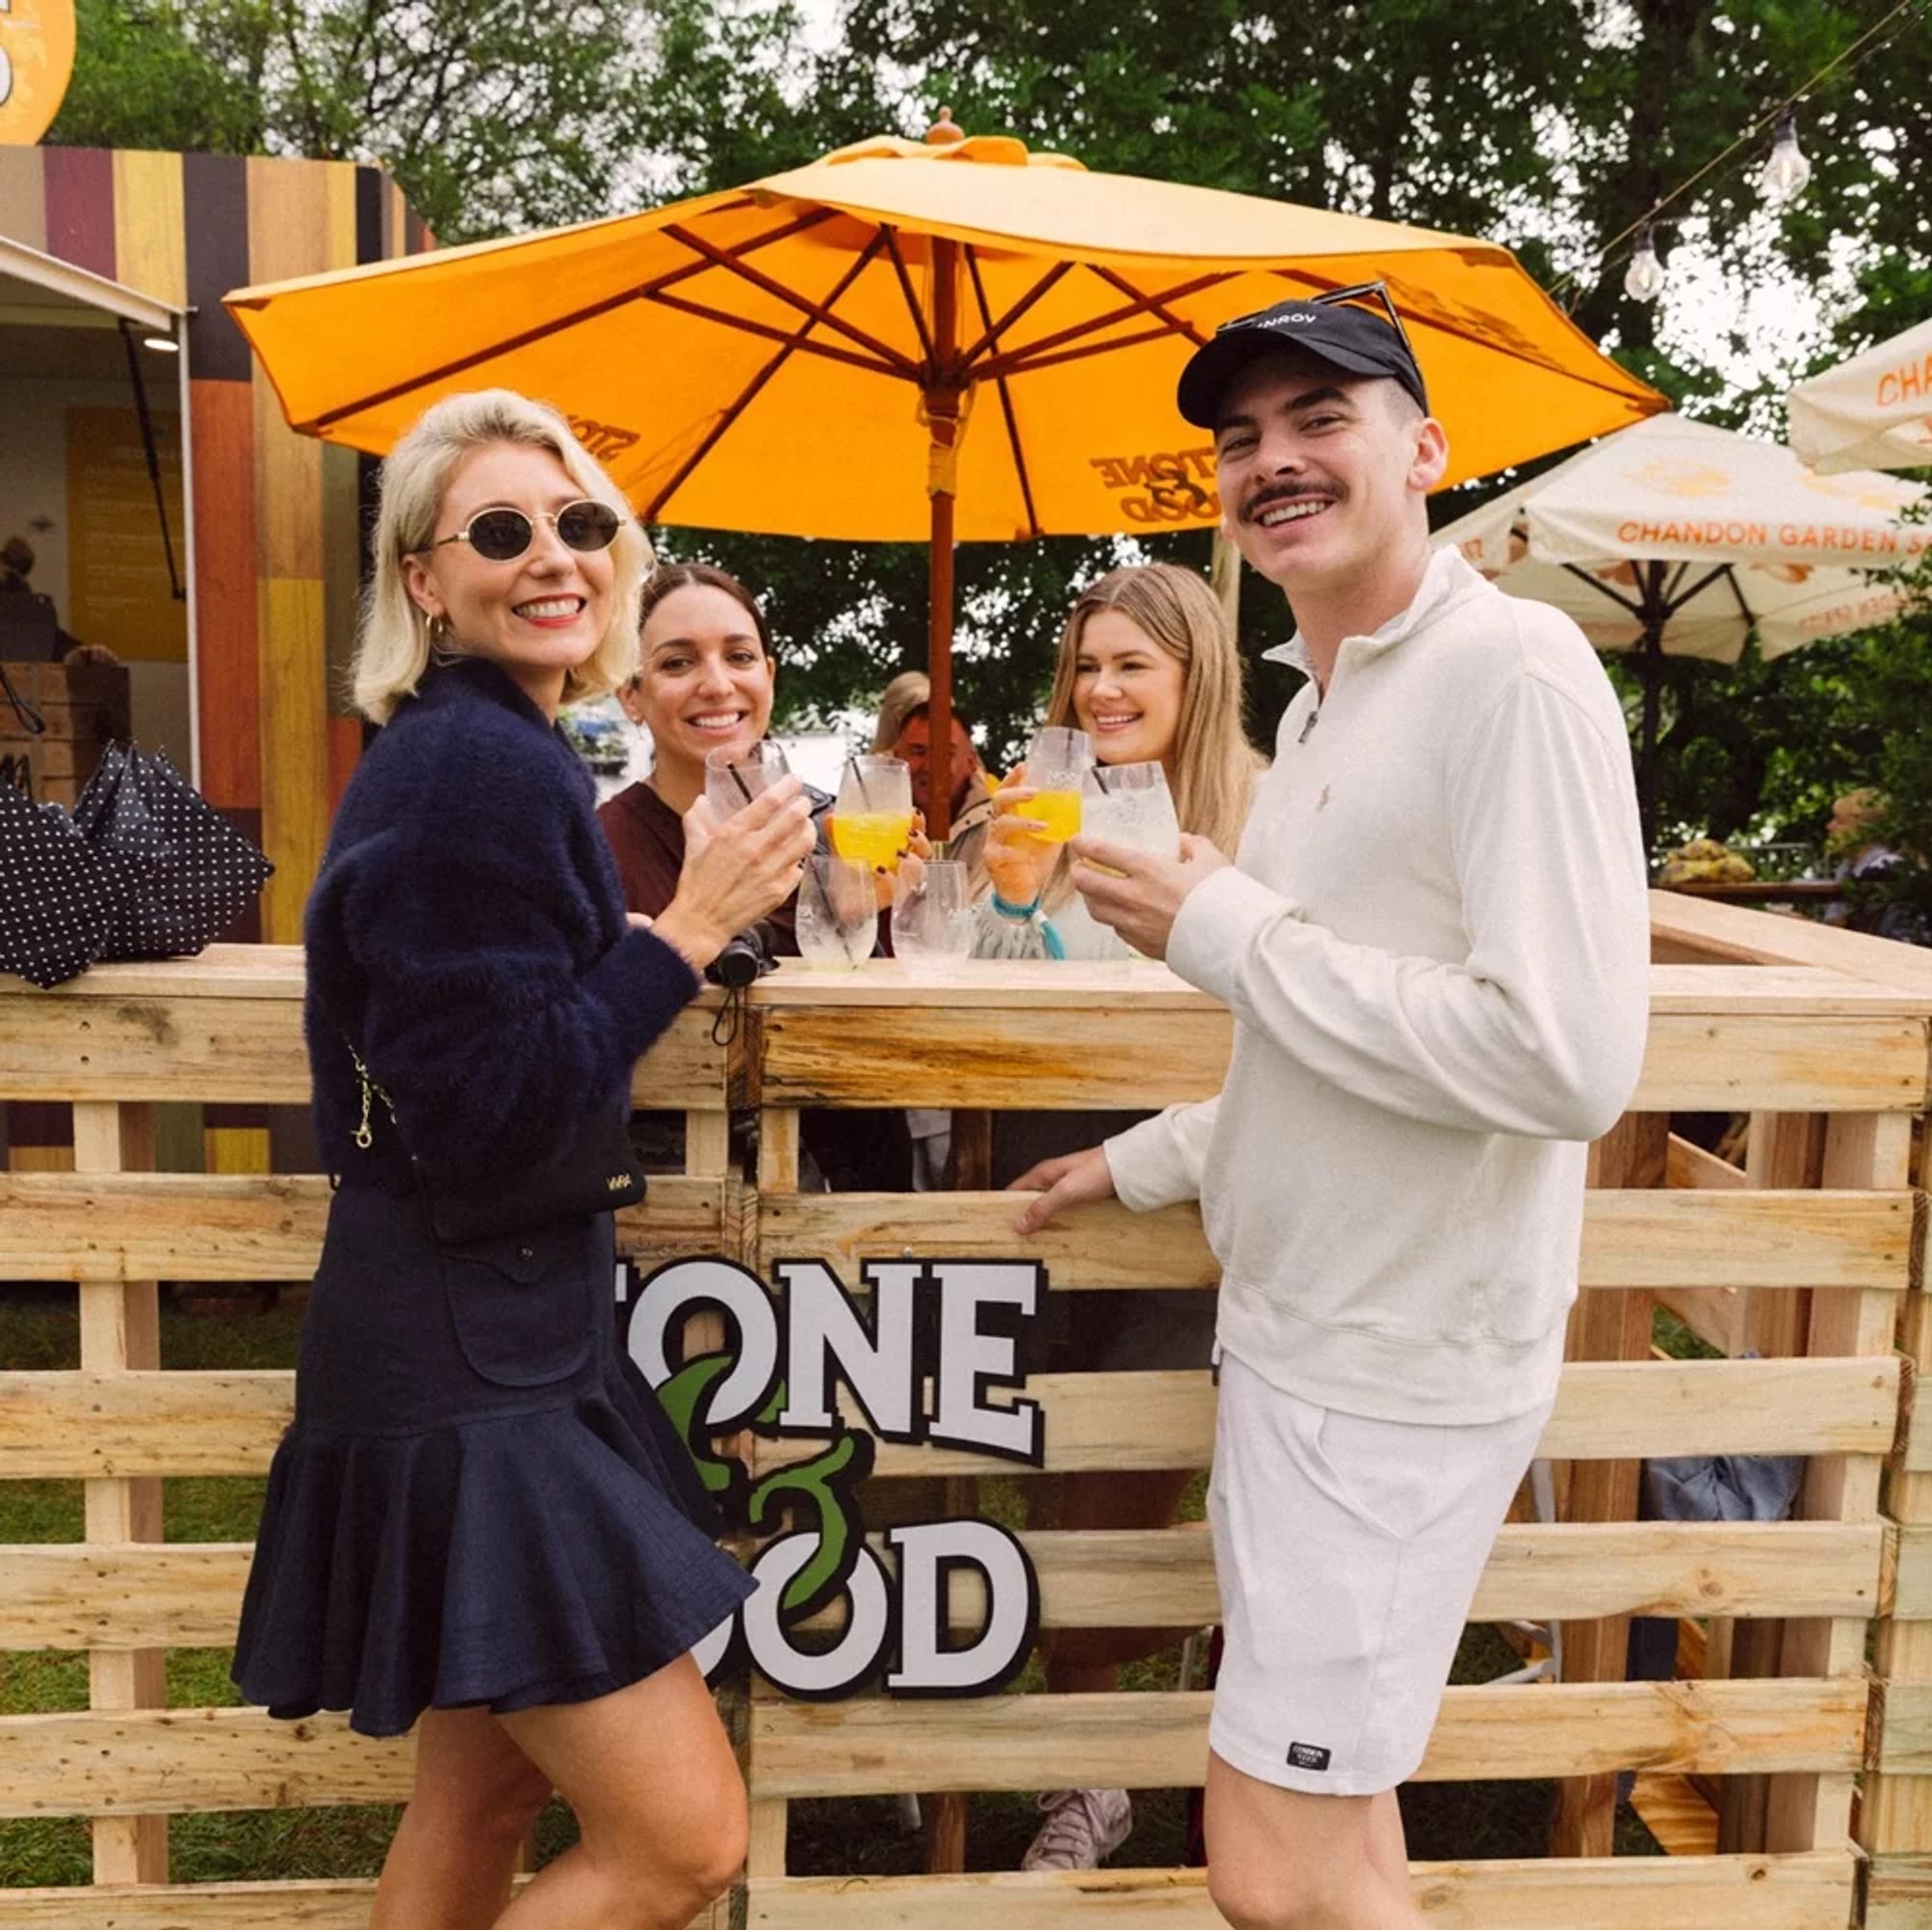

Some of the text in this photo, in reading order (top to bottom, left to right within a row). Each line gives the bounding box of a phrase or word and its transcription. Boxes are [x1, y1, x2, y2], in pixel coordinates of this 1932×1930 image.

[1617, 522, 1767, 546] CHANDON
[1778, 525, 1897, 555] GARDEN
[614, 1259, 1045, 1464] ONE
[690, 1518, 1032, 1692] OD
